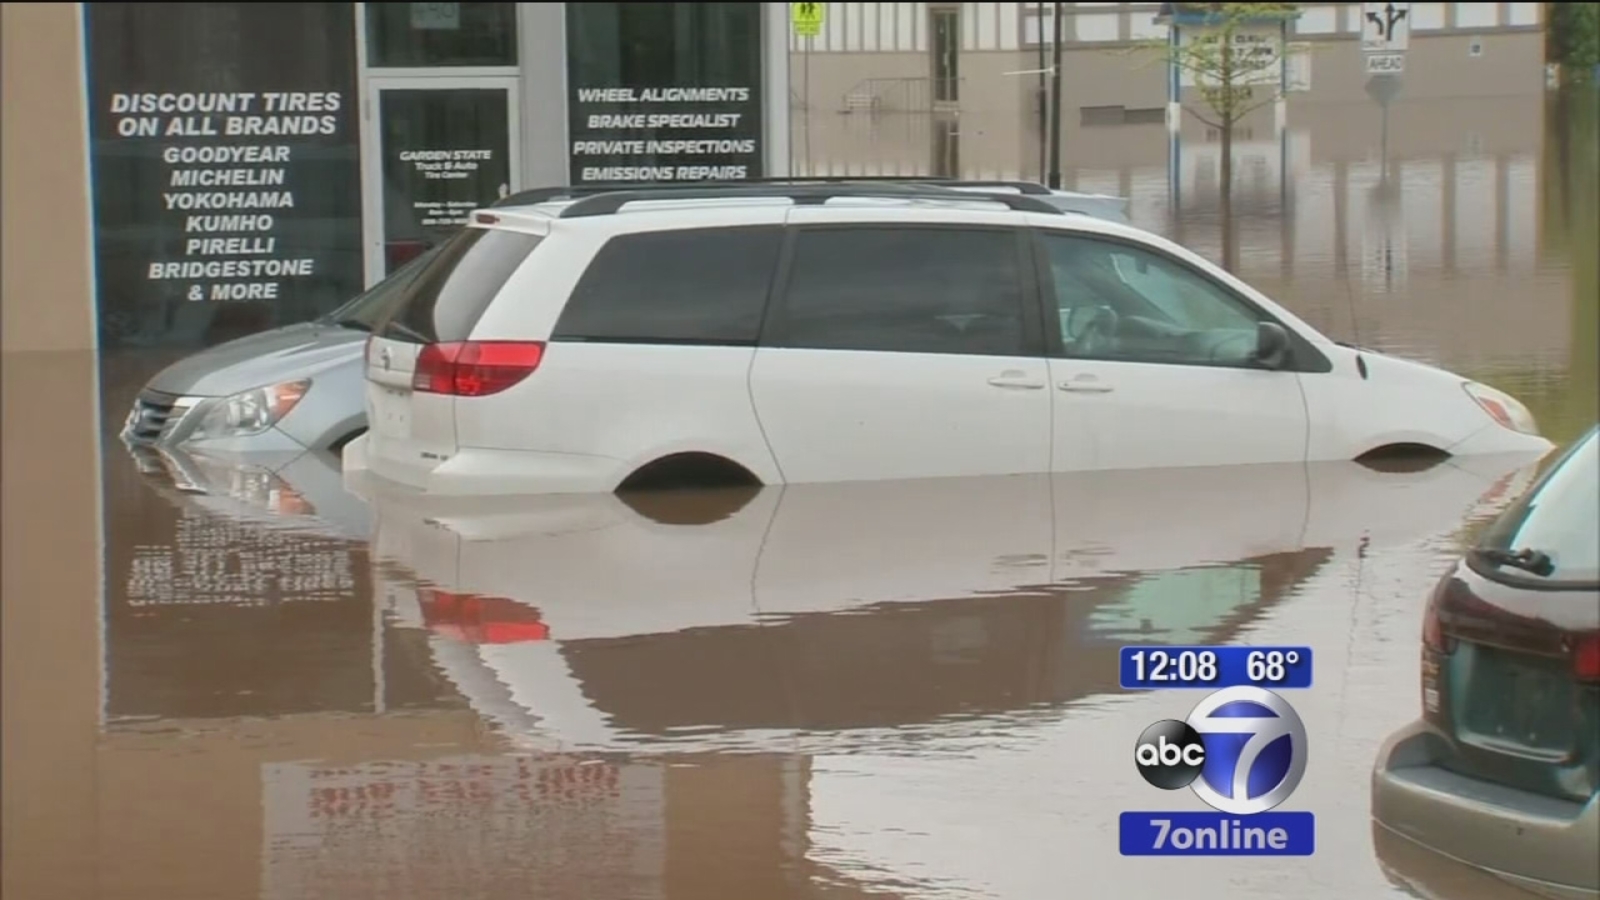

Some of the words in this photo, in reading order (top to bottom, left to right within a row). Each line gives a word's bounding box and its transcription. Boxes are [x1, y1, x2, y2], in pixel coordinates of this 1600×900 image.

[1369, 56, 1403, 70] AHEAD
[111, 93, 254, 113] DISCOUNT
[261, 92, 341, 112] TIRES
[578, 88, 637, 102] WHEEL
[640, 87, 750, 102] ALIGNMENTS
[118, 117, 158, 137] ON
[165, 117, 217, 136] ALL
[225, 115, 336, 135] BRANDS
[587, 114, 646, 128] BRAKE
[647, 113, 741, 127] SPECIALIST
[163, 146, 290, 163] GOODYEAR
[400, 150, 451, 161] GARDEN
[453, 149, 492, 160] STATE
[573, 140, 645, 155] PRIVATE
[646, 139, 755, 154] INSPECTIONS
[453, 161, 478, 170] Auto
[582, 166, 675, 181] EMISSIONS
[676, 165, 747, 180] REPAIRS
[170, 168, 285, 186] MICHELIN
[163, 191, 294, 210] YOKOHAMA
[186, 214, 273, 232] KUMHO
[186, 238, 275, 255] PIRELLI
[148, 259, 314, 279] BRIDGESTONE
[188, 285, 203, 301] &
[210, 282, 279, 300] MORE
